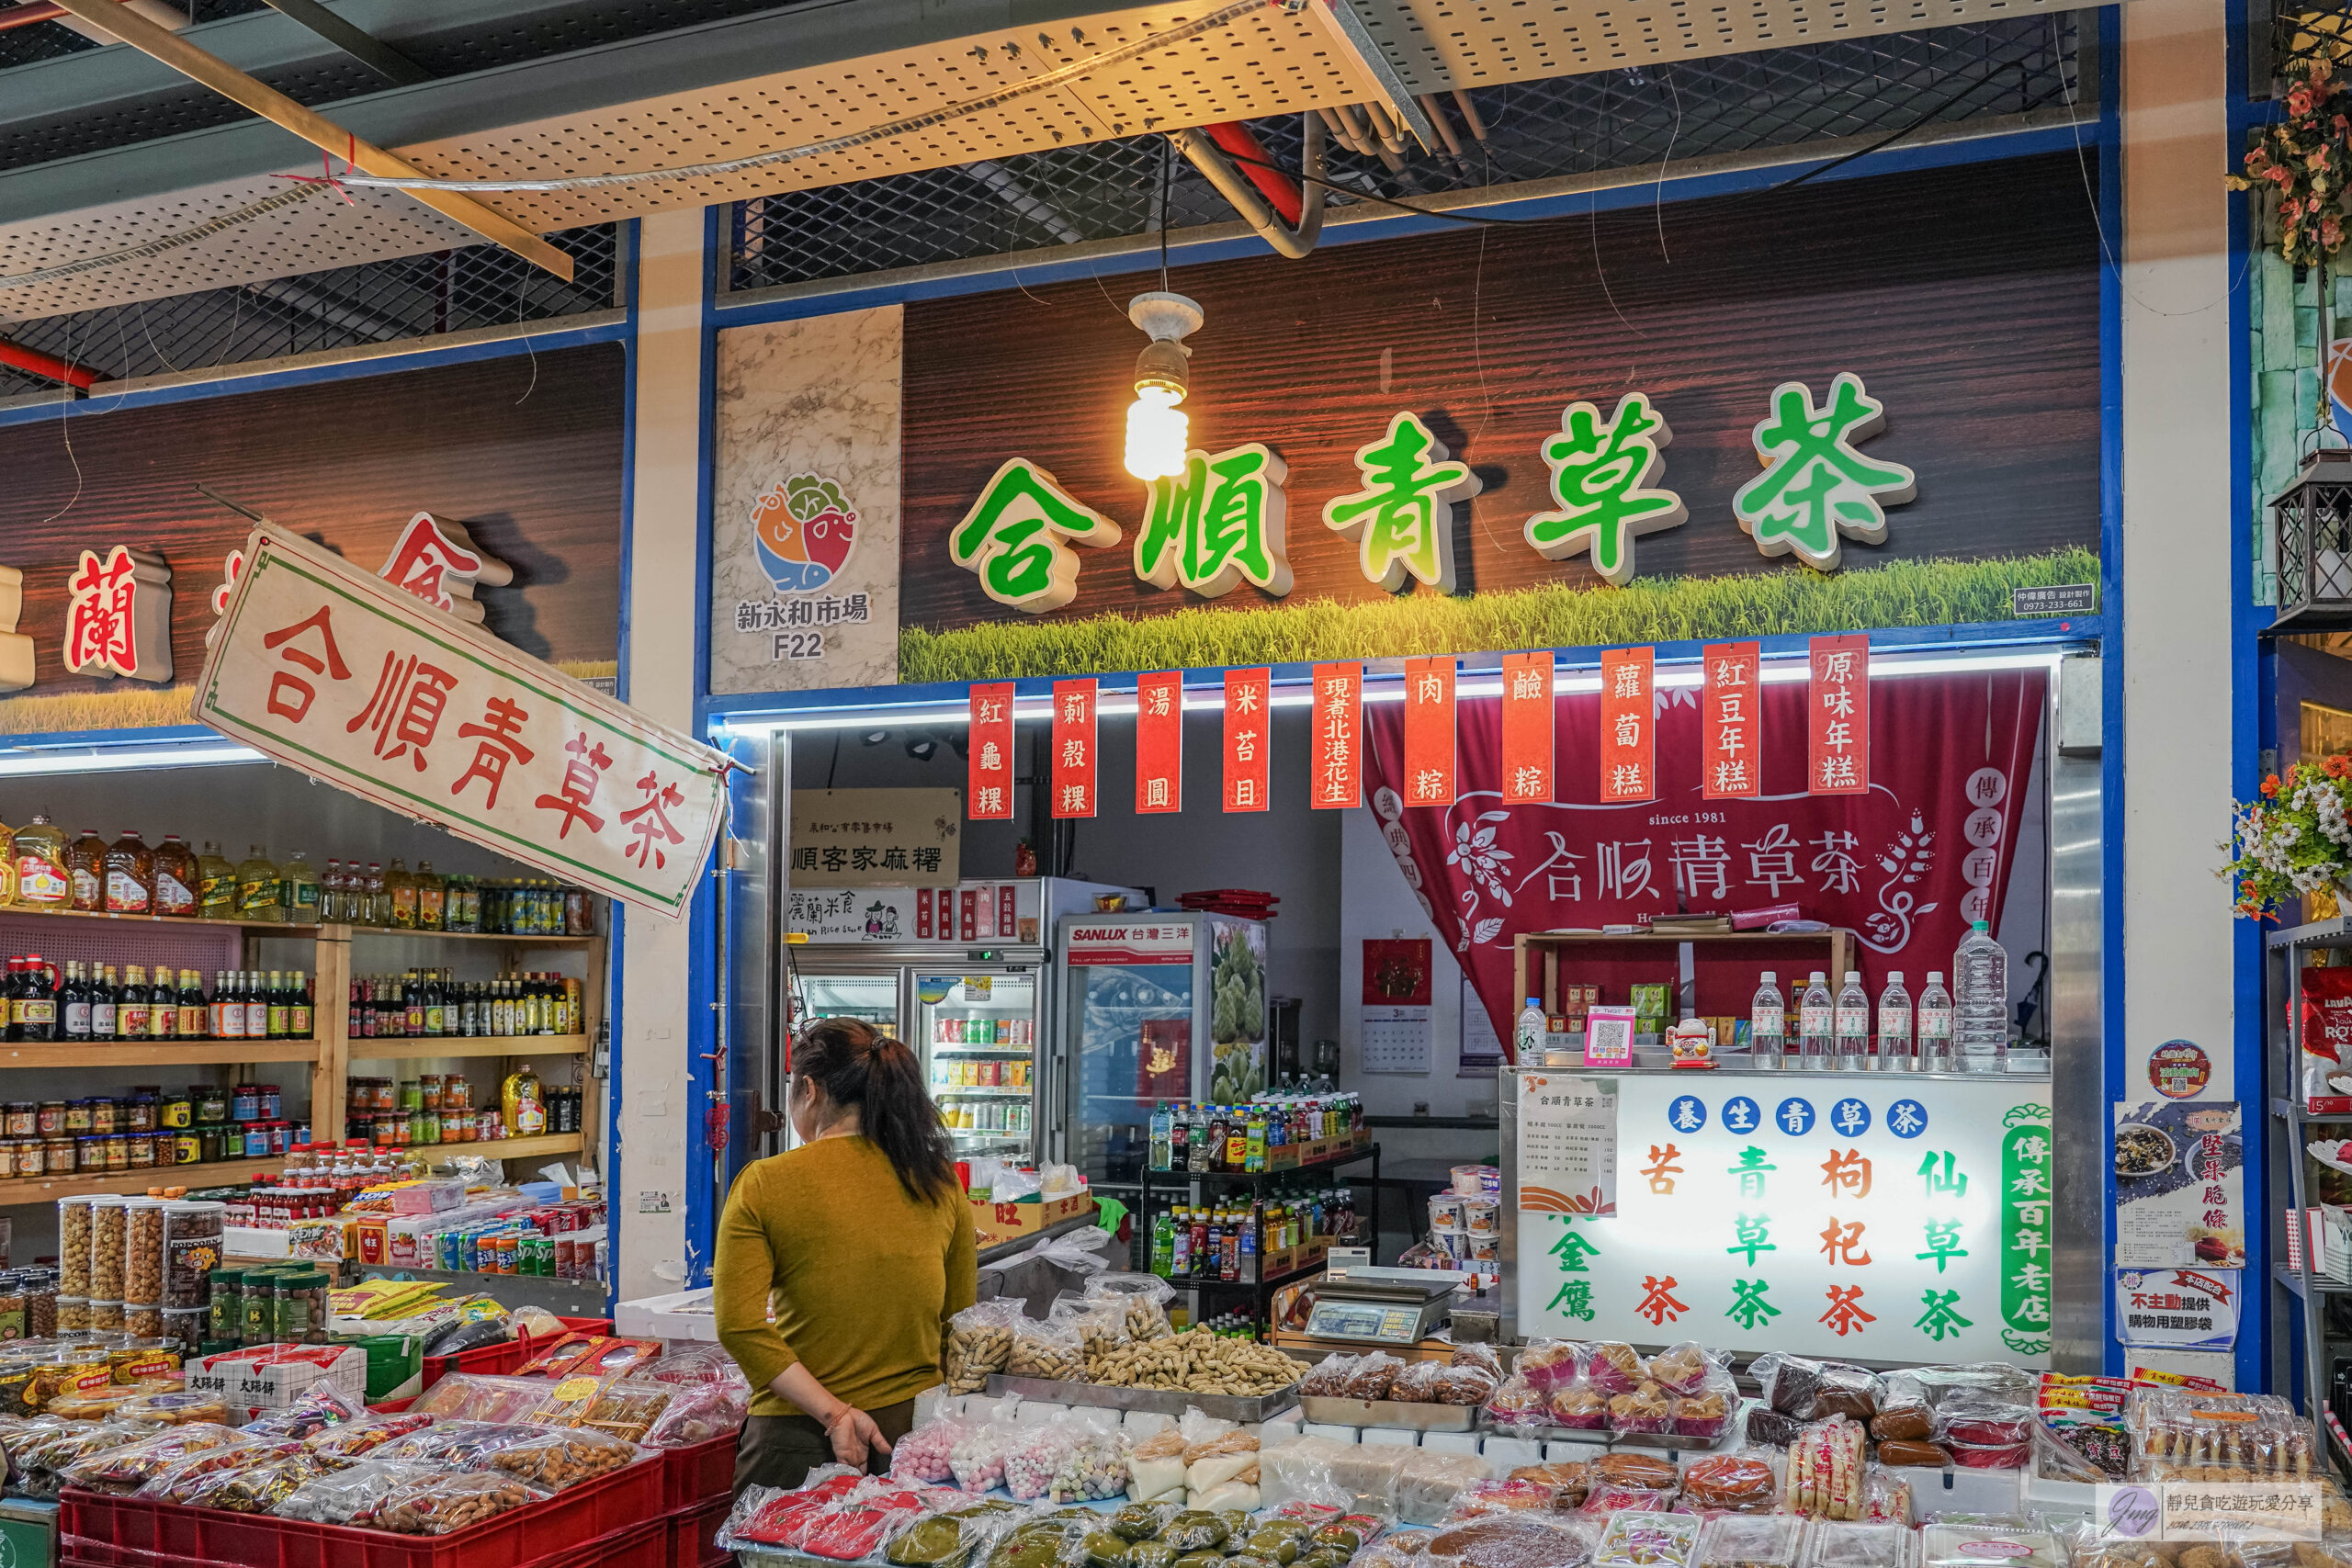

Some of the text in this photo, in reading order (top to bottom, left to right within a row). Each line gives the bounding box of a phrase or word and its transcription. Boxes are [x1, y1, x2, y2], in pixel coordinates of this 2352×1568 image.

[952, 375, 1915, 603] 合順青草茶
[737, 594, 871, 630] 新永和市場
[775, 633, 821, 659] F22
[2018, 590, 2090, 601] 仲偉廣告 設計製作
[2023, 600, 2084, 610] 0973-233-661
[264, 604, 685, 871] 合順青草茶
[978, 698, 1004, 815] 紅龜粿
[1147, 687, 1170, 807] 湯圓
[1235, 683, 1259, 807] 米苔目
[1323, 678, 1351, 803] 現煮北港花生
[1416, 674, 1445, 801] 肉粽
[1512, 671, 1544, 799] 鹼粽
[1611, 664, 1645, 797] 蘿蔔糕
[1715, 659, 1747, 793] 紅豆年糕
[1821, 653, 1855, 790] 原味年糕
[1694, 812, 1726, 823] 1981
[1072, 928, 1128, 942] SANLUX
[1132, 927, 1189, 941] 台灣三洋
[1541, 1095, 1595, 1108] 合順青草茶
[1673, 1098, 1924, 1135] 養生青草茶
[995, 1202, 1023, 1227] 旺
[2011, 1134, 2052, 1324] 傳承百年老店
[2201, 1134, 2228, 1231] 堅果脆條
[173, 1237, 219, 1248] POPCORN
[1546, 1216, 1601, 1324] 金鷹
[1634, 1142, 1690, 1326] 苦茶
[1724, 1144, 1782, 1330] 青草茶
[1817, 1146, 1877, 1337] 枸杞茶
[1913, 1149, 1974, 1343] 仙草茶
[2185, 1273, 2222, 1295] 本店配合
[2128, 1314, 2212, 1331] 購物用塑膠袋
[2131, 1292, 2211, 1312] 不主動提供
[190, 1375, 226, 1393] 太陽餅
[239, 1379, 276, 1397] 太陽餅
